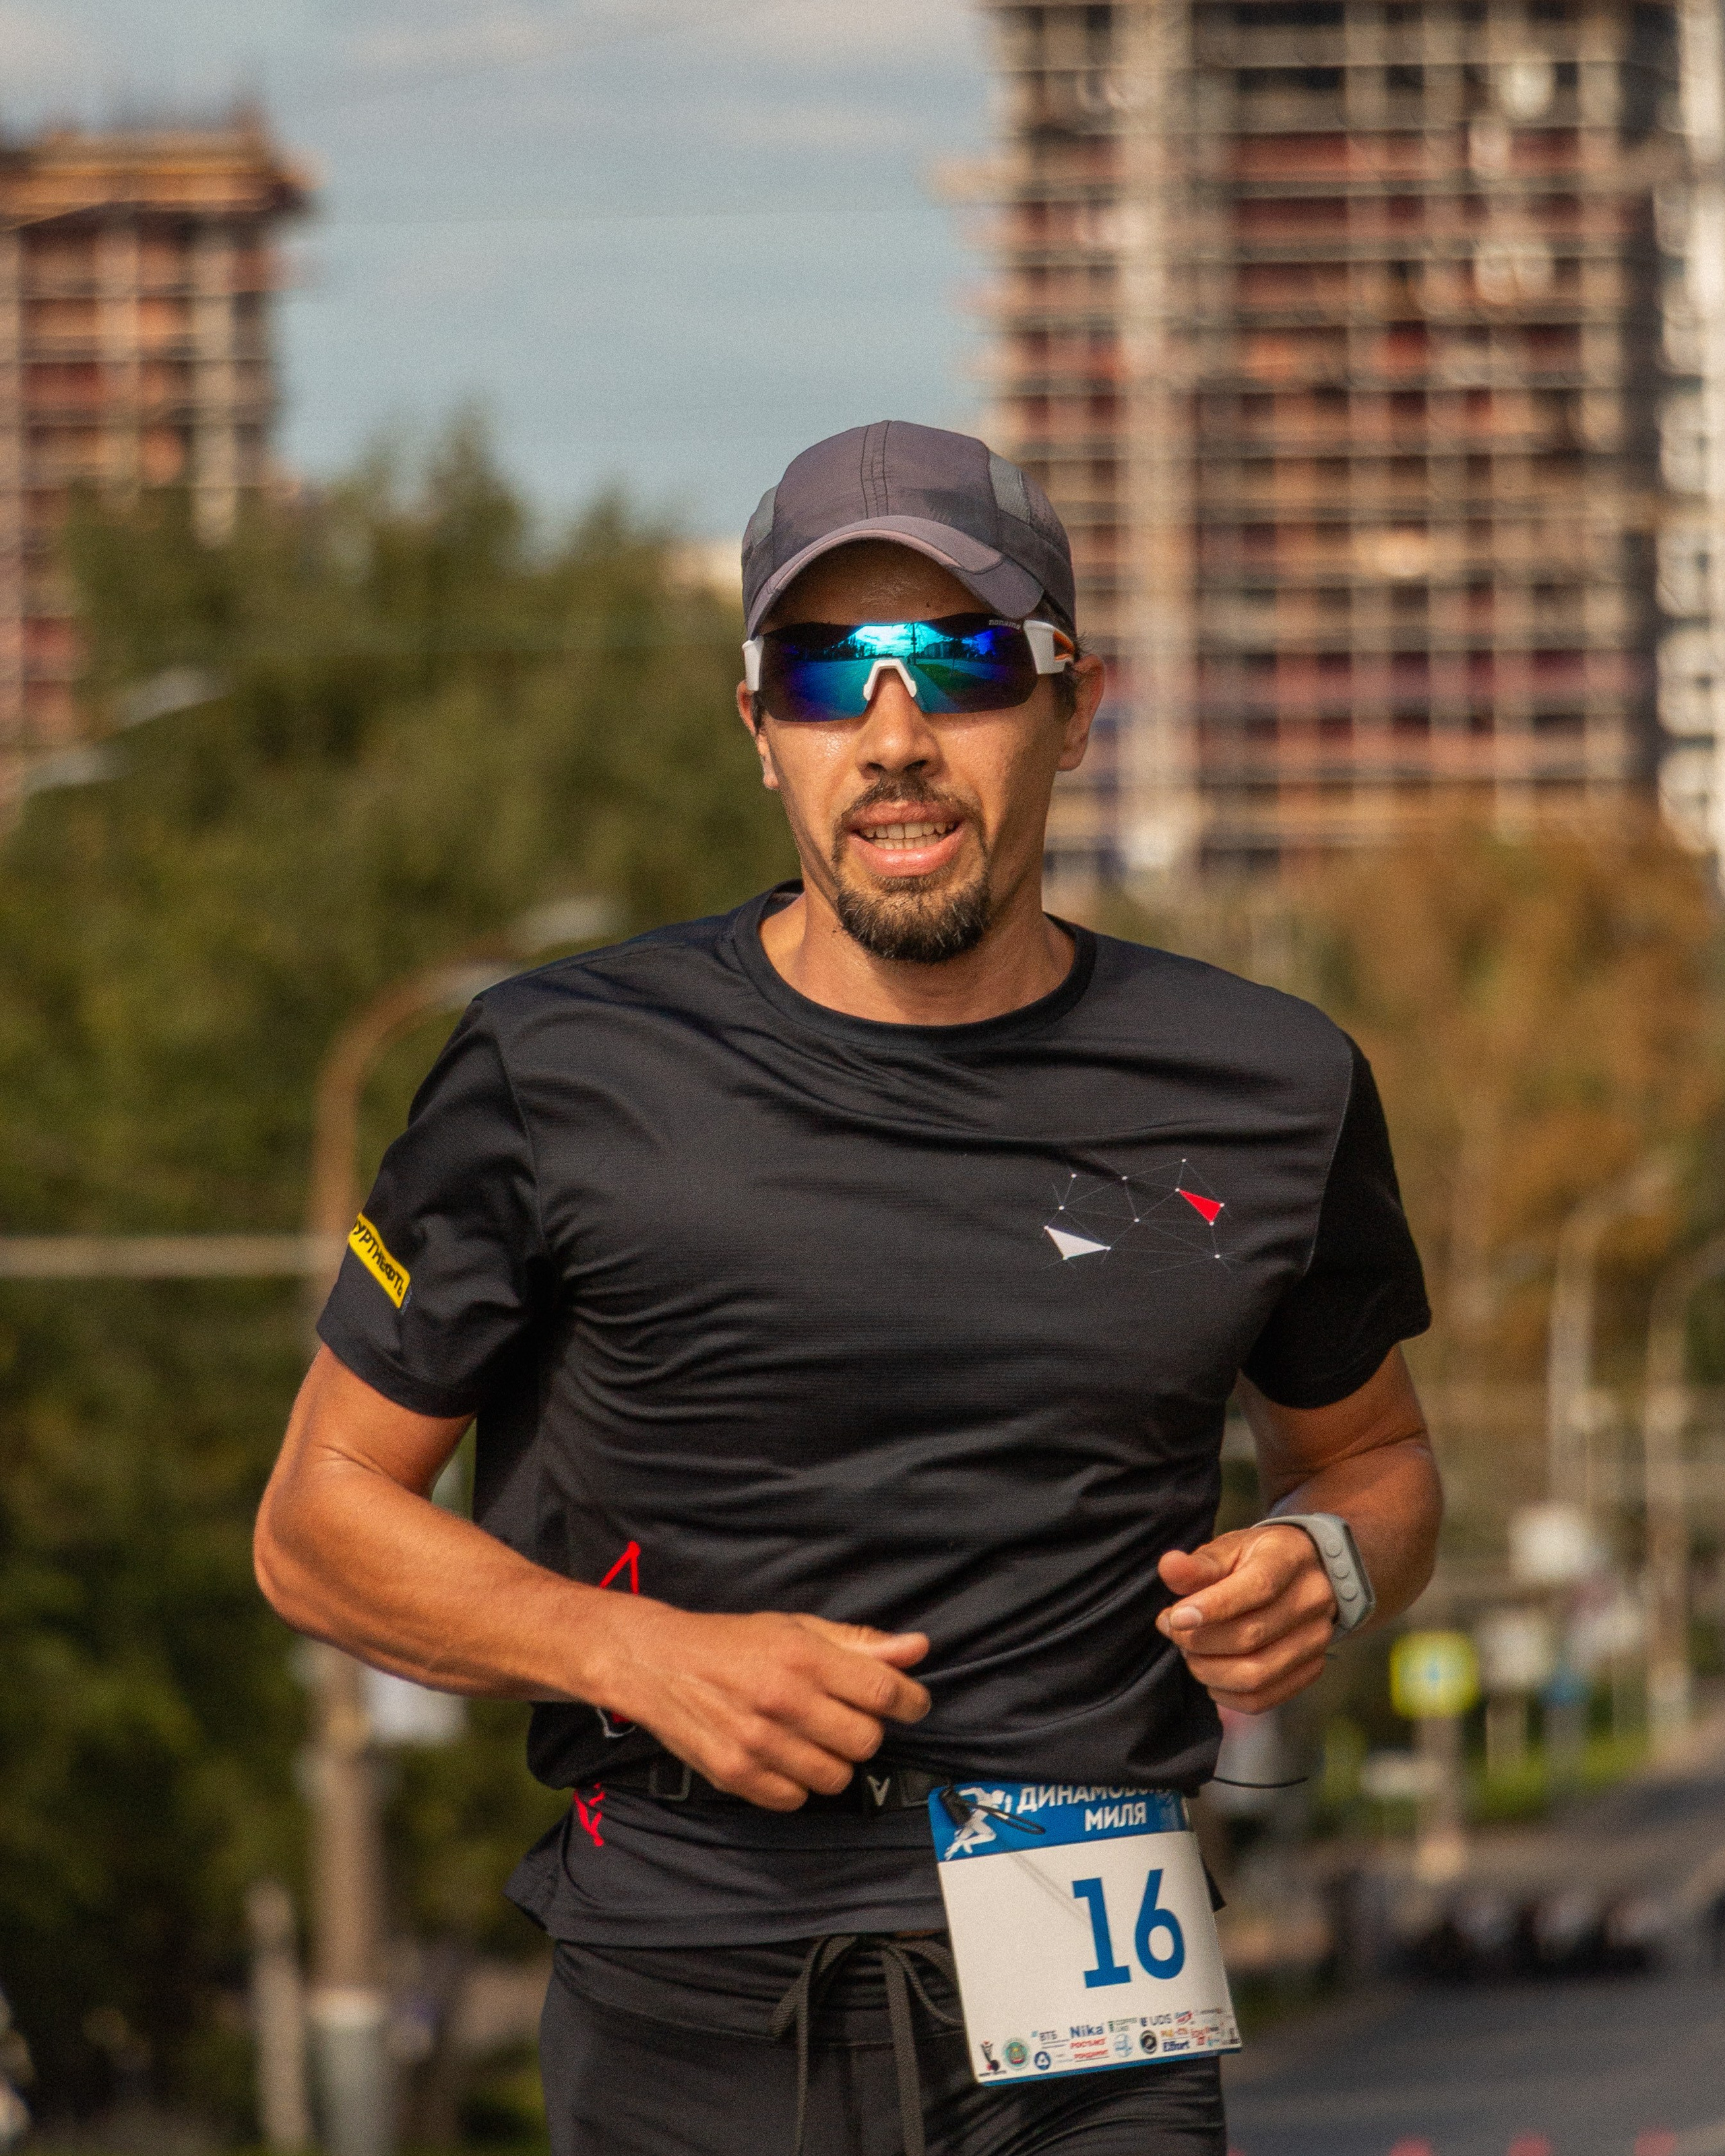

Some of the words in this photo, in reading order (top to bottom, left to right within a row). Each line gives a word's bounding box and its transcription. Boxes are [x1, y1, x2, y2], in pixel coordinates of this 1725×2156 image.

[1084, 1802, 1147, 1832] МИЛЯ
[1071, 1868, 1186, 1989] 16
[1069, 2024, 1104, 2039] Nika
